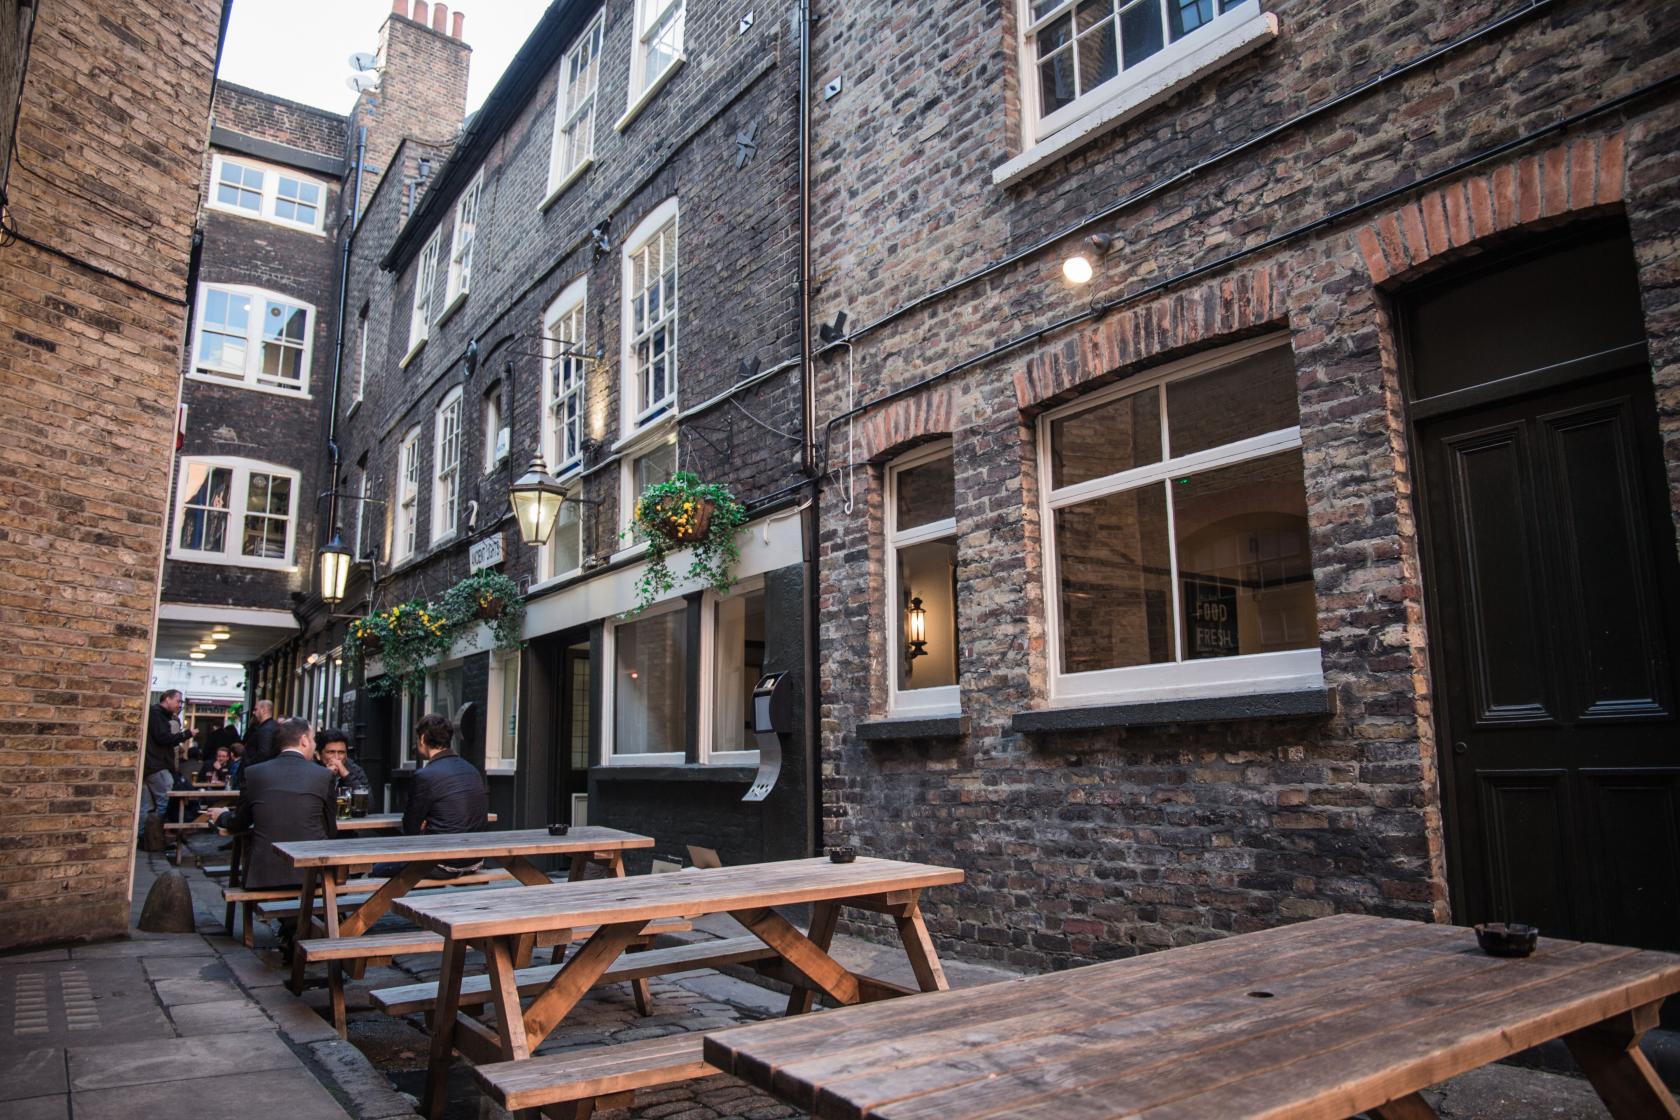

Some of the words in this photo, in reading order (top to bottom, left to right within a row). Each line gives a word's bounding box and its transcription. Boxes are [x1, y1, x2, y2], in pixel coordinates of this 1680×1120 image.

[1196, 601, 1228, 622] FOOD
[1196, 627, 1233, 648] FRESH
[200, 674, 229, 687] TAS
